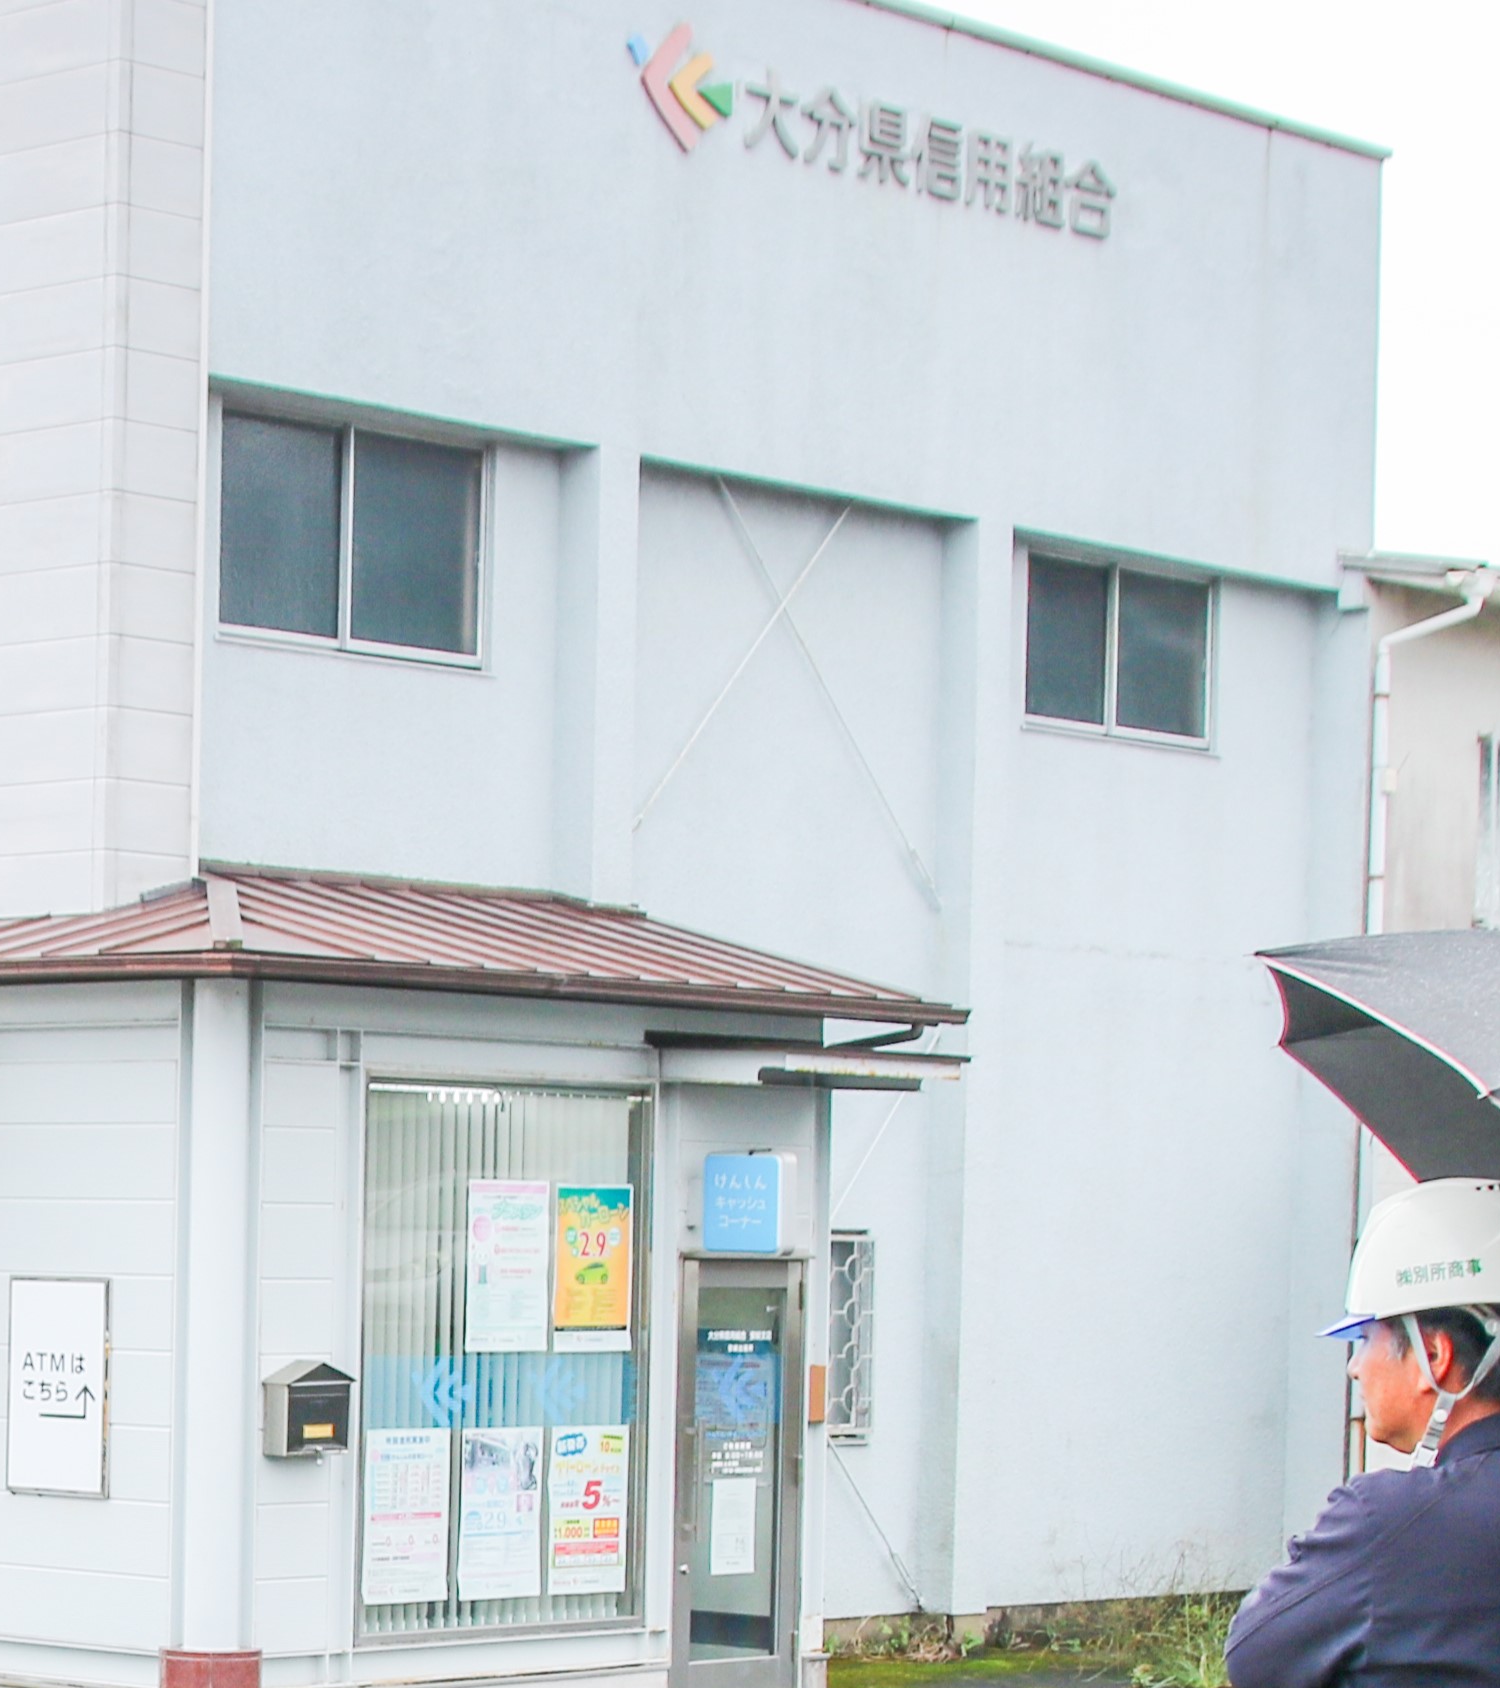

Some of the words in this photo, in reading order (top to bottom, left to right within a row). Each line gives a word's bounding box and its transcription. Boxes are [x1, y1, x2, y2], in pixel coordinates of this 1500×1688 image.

[742, 69, 1118, 239] 大分県信用組合
[714, 1173, 767, 1190] けんしん
[715, 1196, 766, 1211] キャッシュ
[719, 1215, 763, 1229] コーナー
[22, 1352, 86, 1374] ATMは
[22, 1380, 69, 1402] こちら
